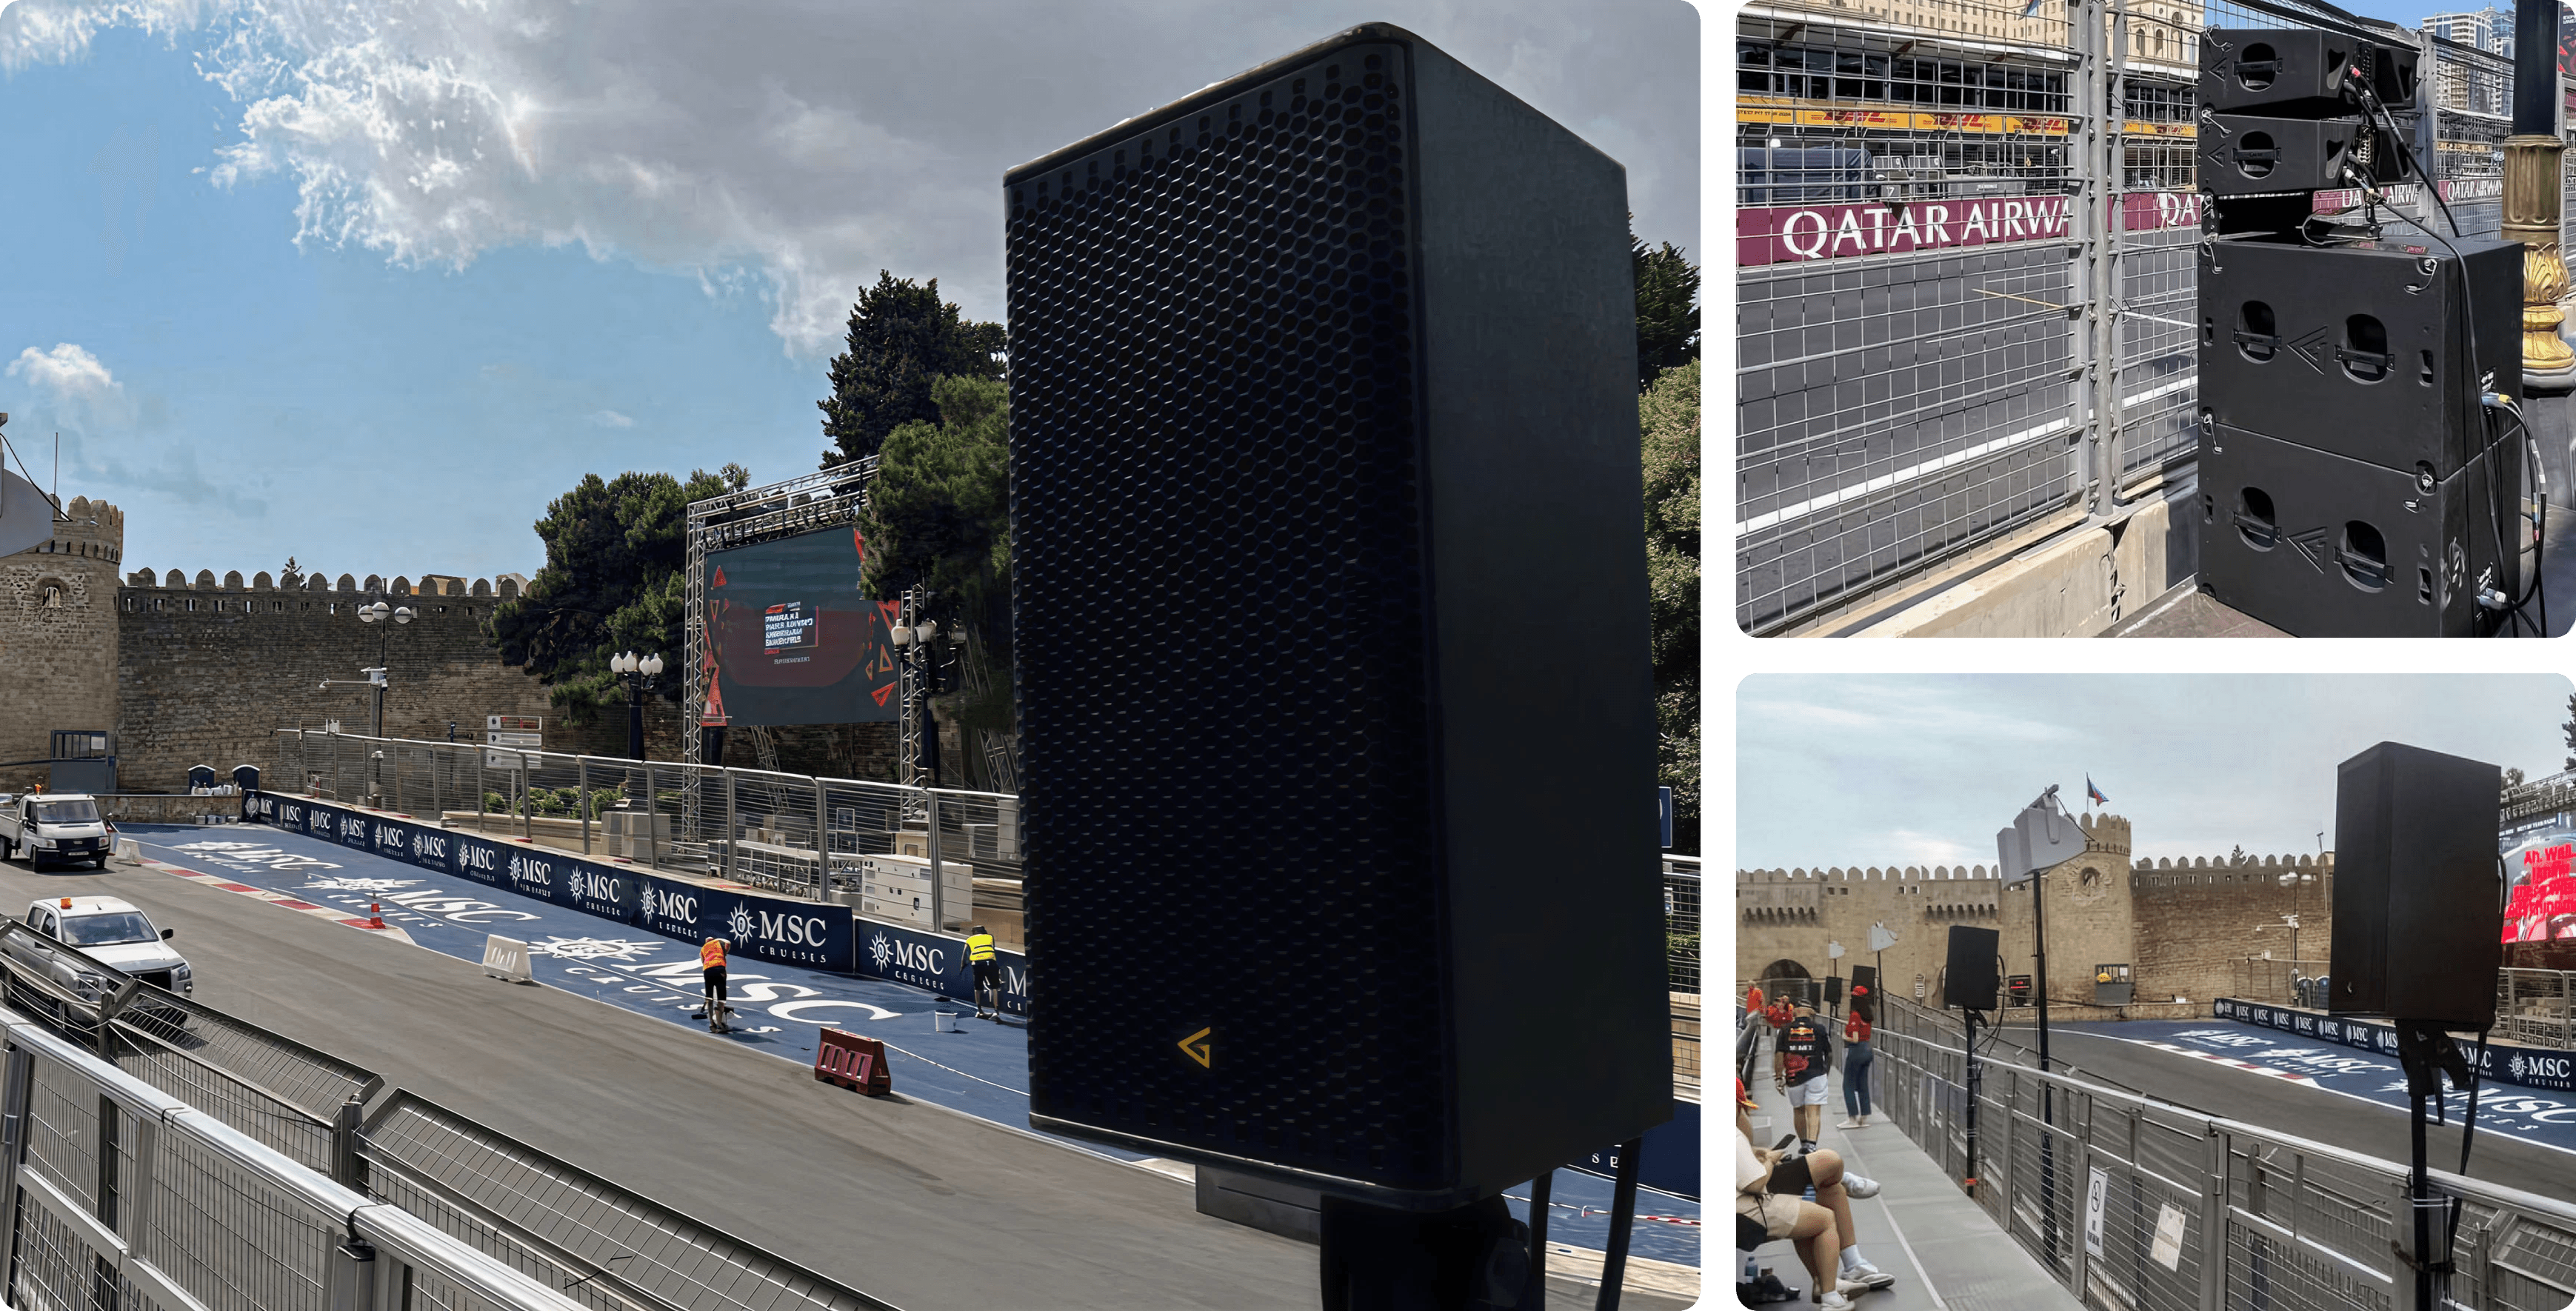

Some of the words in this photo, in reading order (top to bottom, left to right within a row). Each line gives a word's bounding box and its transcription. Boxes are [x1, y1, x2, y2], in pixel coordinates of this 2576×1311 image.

[2447, 181, 2475, 201] QATAR
[2475, 179, 2503, 197] AIRWAY
[1783, 205, 1952, 259] QATAR
[1963, 199, 2069, 241] AIRWA
[424, 835, 446, 858] MSC
[470, 845, 495, 870] MSC
[522, 858, 551, 885] MSC
[586, 872, 621, 903] MSC
[365, 890, 542, 923] MSC
[658, 890, 698, 924] MSC
[759, 911, 826, 947] MSC
[895, 939, 944, 975] MSC
[565, 967, 782, 1033] CRUISS
[611, 958, 902, 1024] MSC
[2467, 1047, 2492, 1068] MC
[2528, 1056, 2570, 1078] MSC
